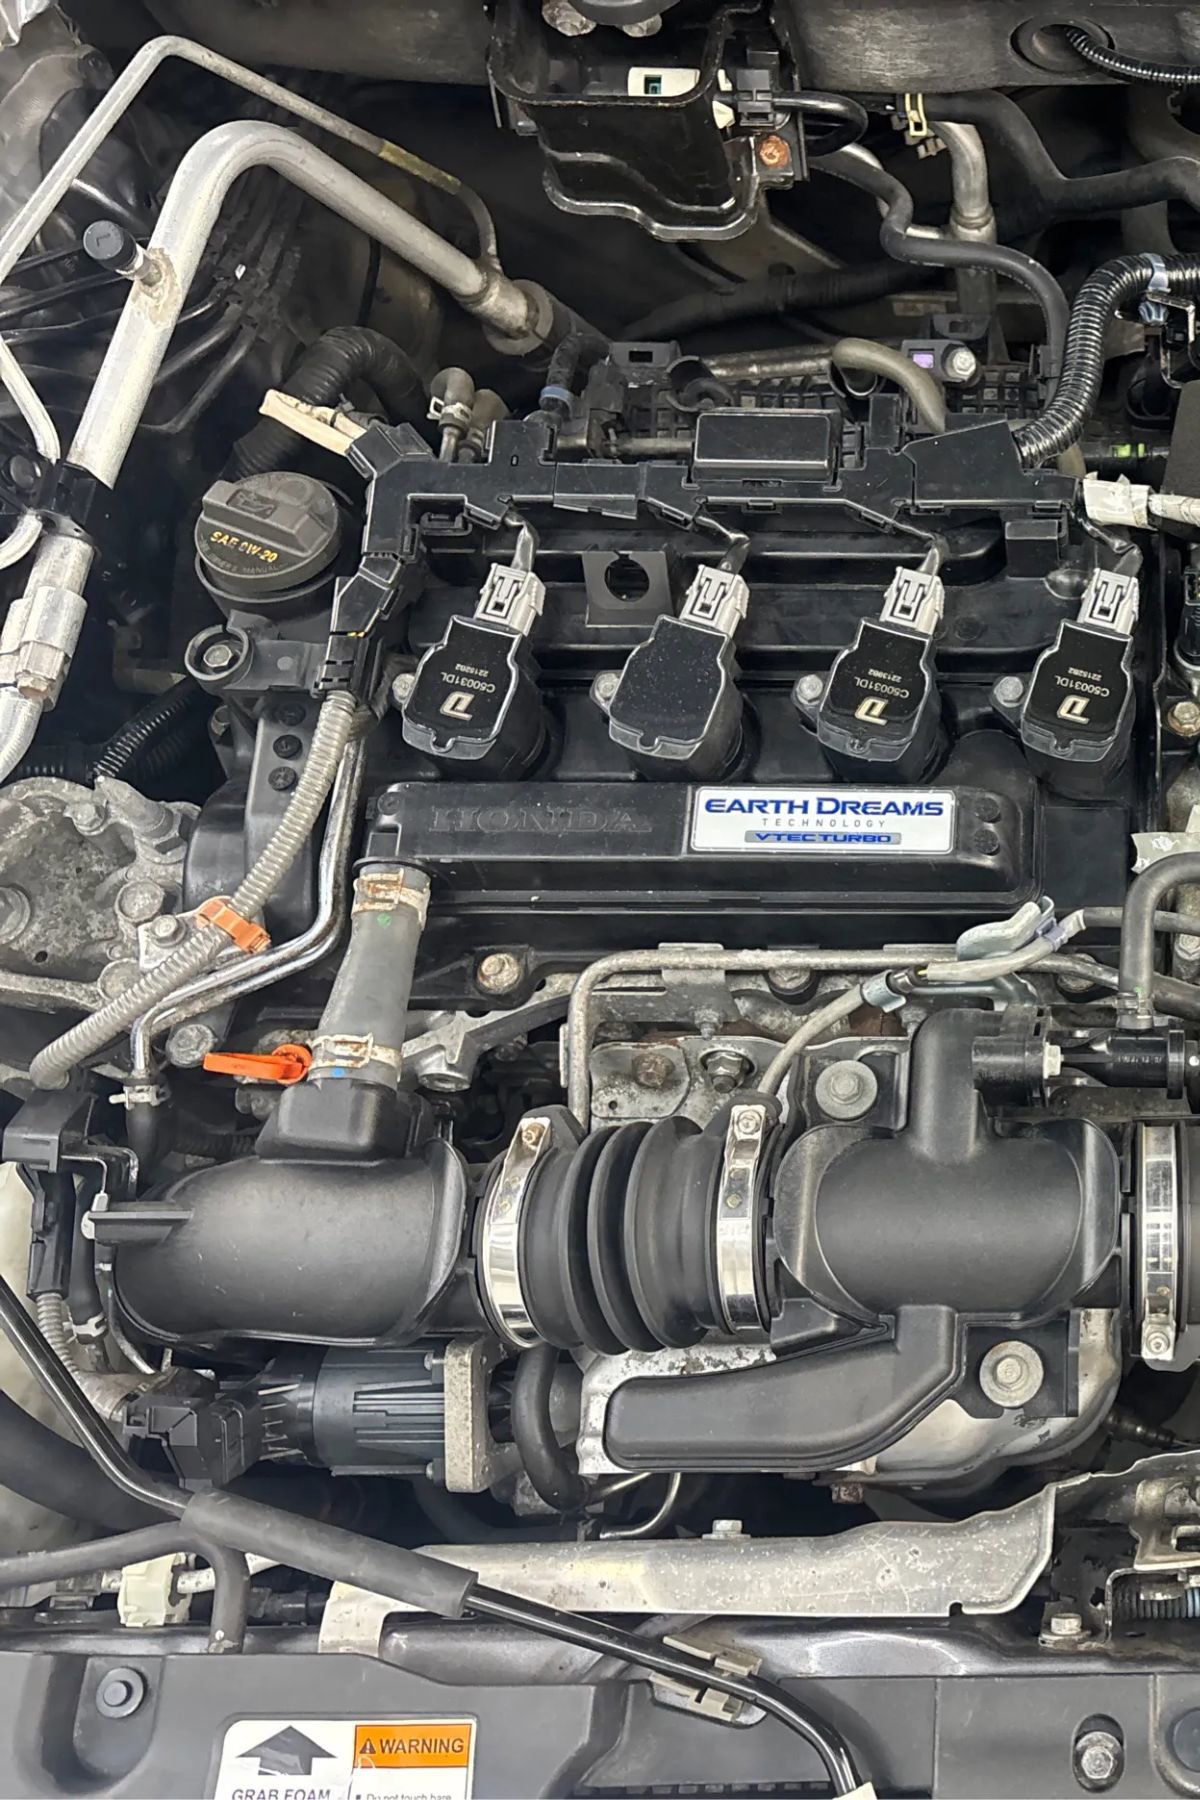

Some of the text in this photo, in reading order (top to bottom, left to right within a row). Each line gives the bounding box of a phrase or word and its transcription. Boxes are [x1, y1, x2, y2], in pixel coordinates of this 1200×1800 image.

[210, 530, 240, 549] SAE
[440, 672, 496, 693] C50031DL
[854, 676, 910, 698] C50031DL
[1054, 675, 1110, 698] C50031DL
[705, 797, 944, 816] EARTH DREAMS
[430, 806, 653, 832] HONDA
[762, 818, 886, 828] TECHNOLOGY
[756, 833, 892, 843] VTEC TURBO
[380, 1738, 464, 1754] WARNING
[232, 1788, 331, 1800] GRAB FOAM
